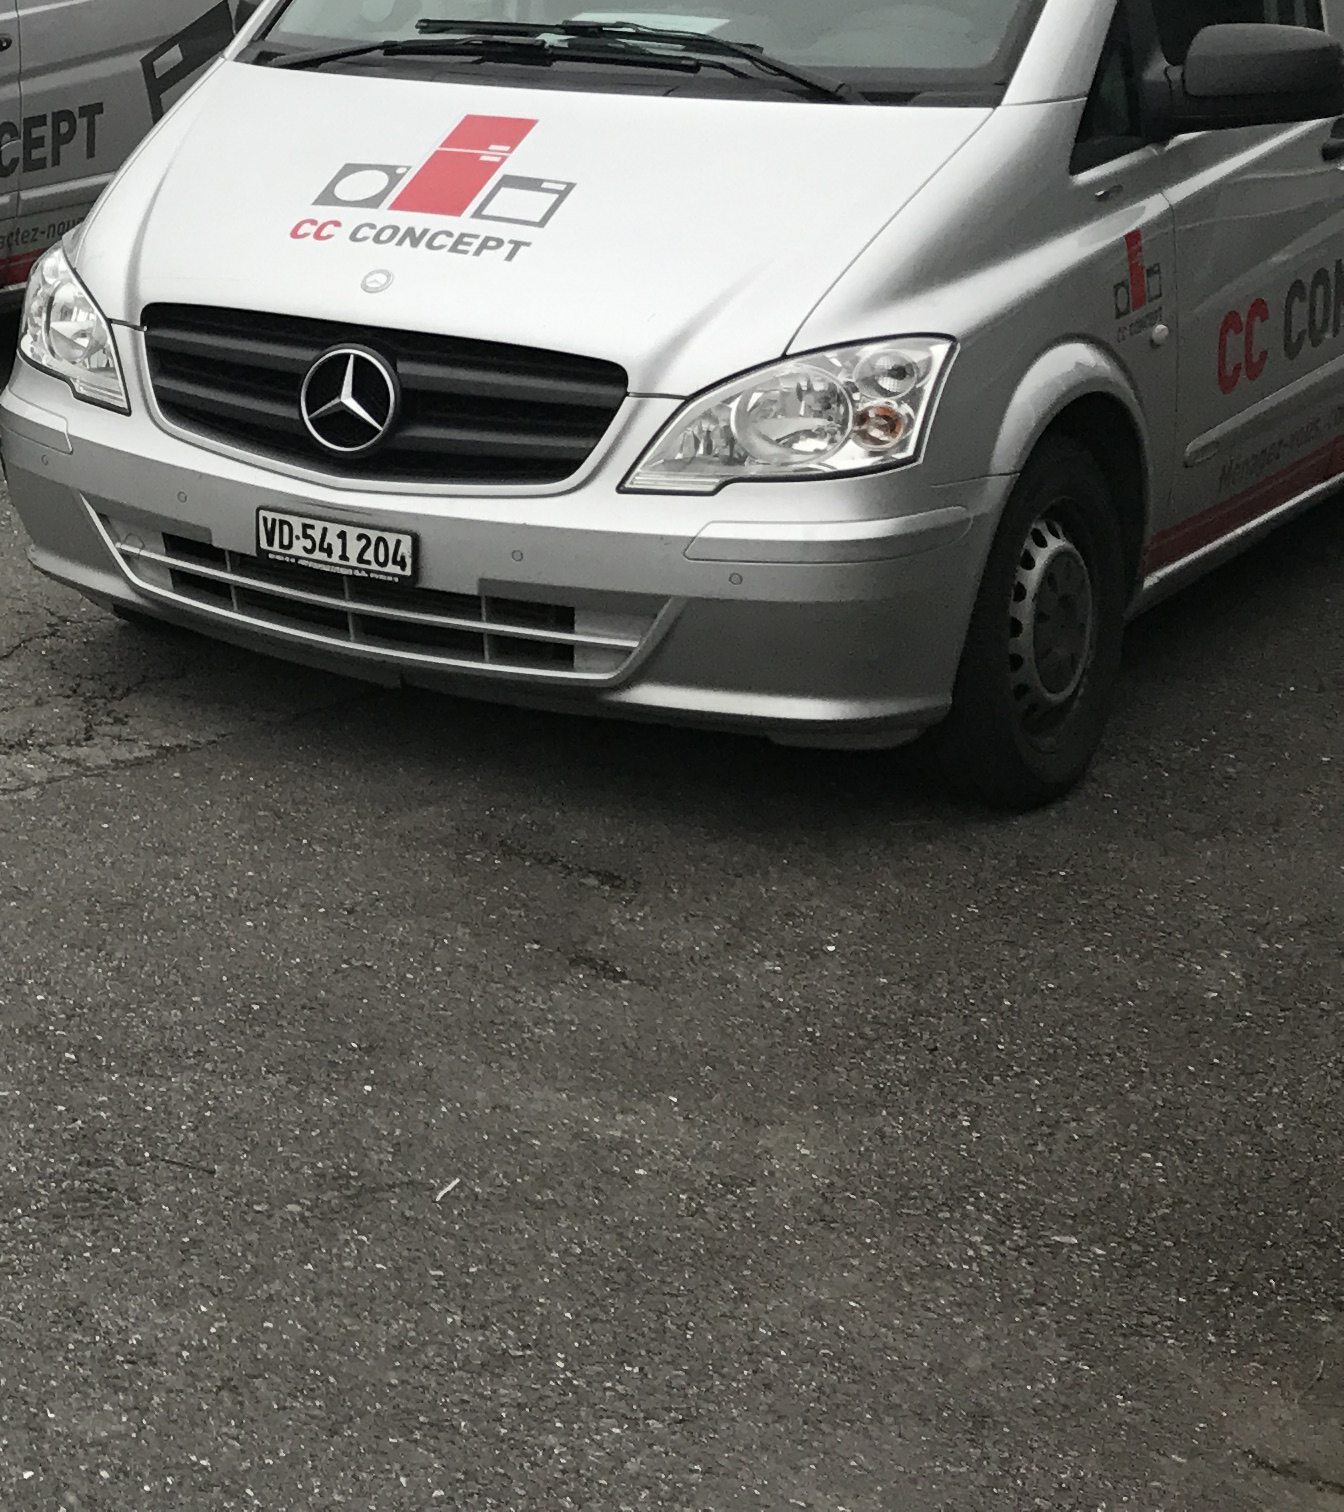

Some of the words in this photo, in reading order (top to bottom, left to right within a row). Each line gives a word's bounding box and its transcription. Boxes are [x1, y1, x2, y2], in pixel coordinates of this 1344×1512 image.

[289, 218, 342, 241] CC
[348, 222, 533, 262] CONCEPT
[1217, 297, 1269, 395] CC
